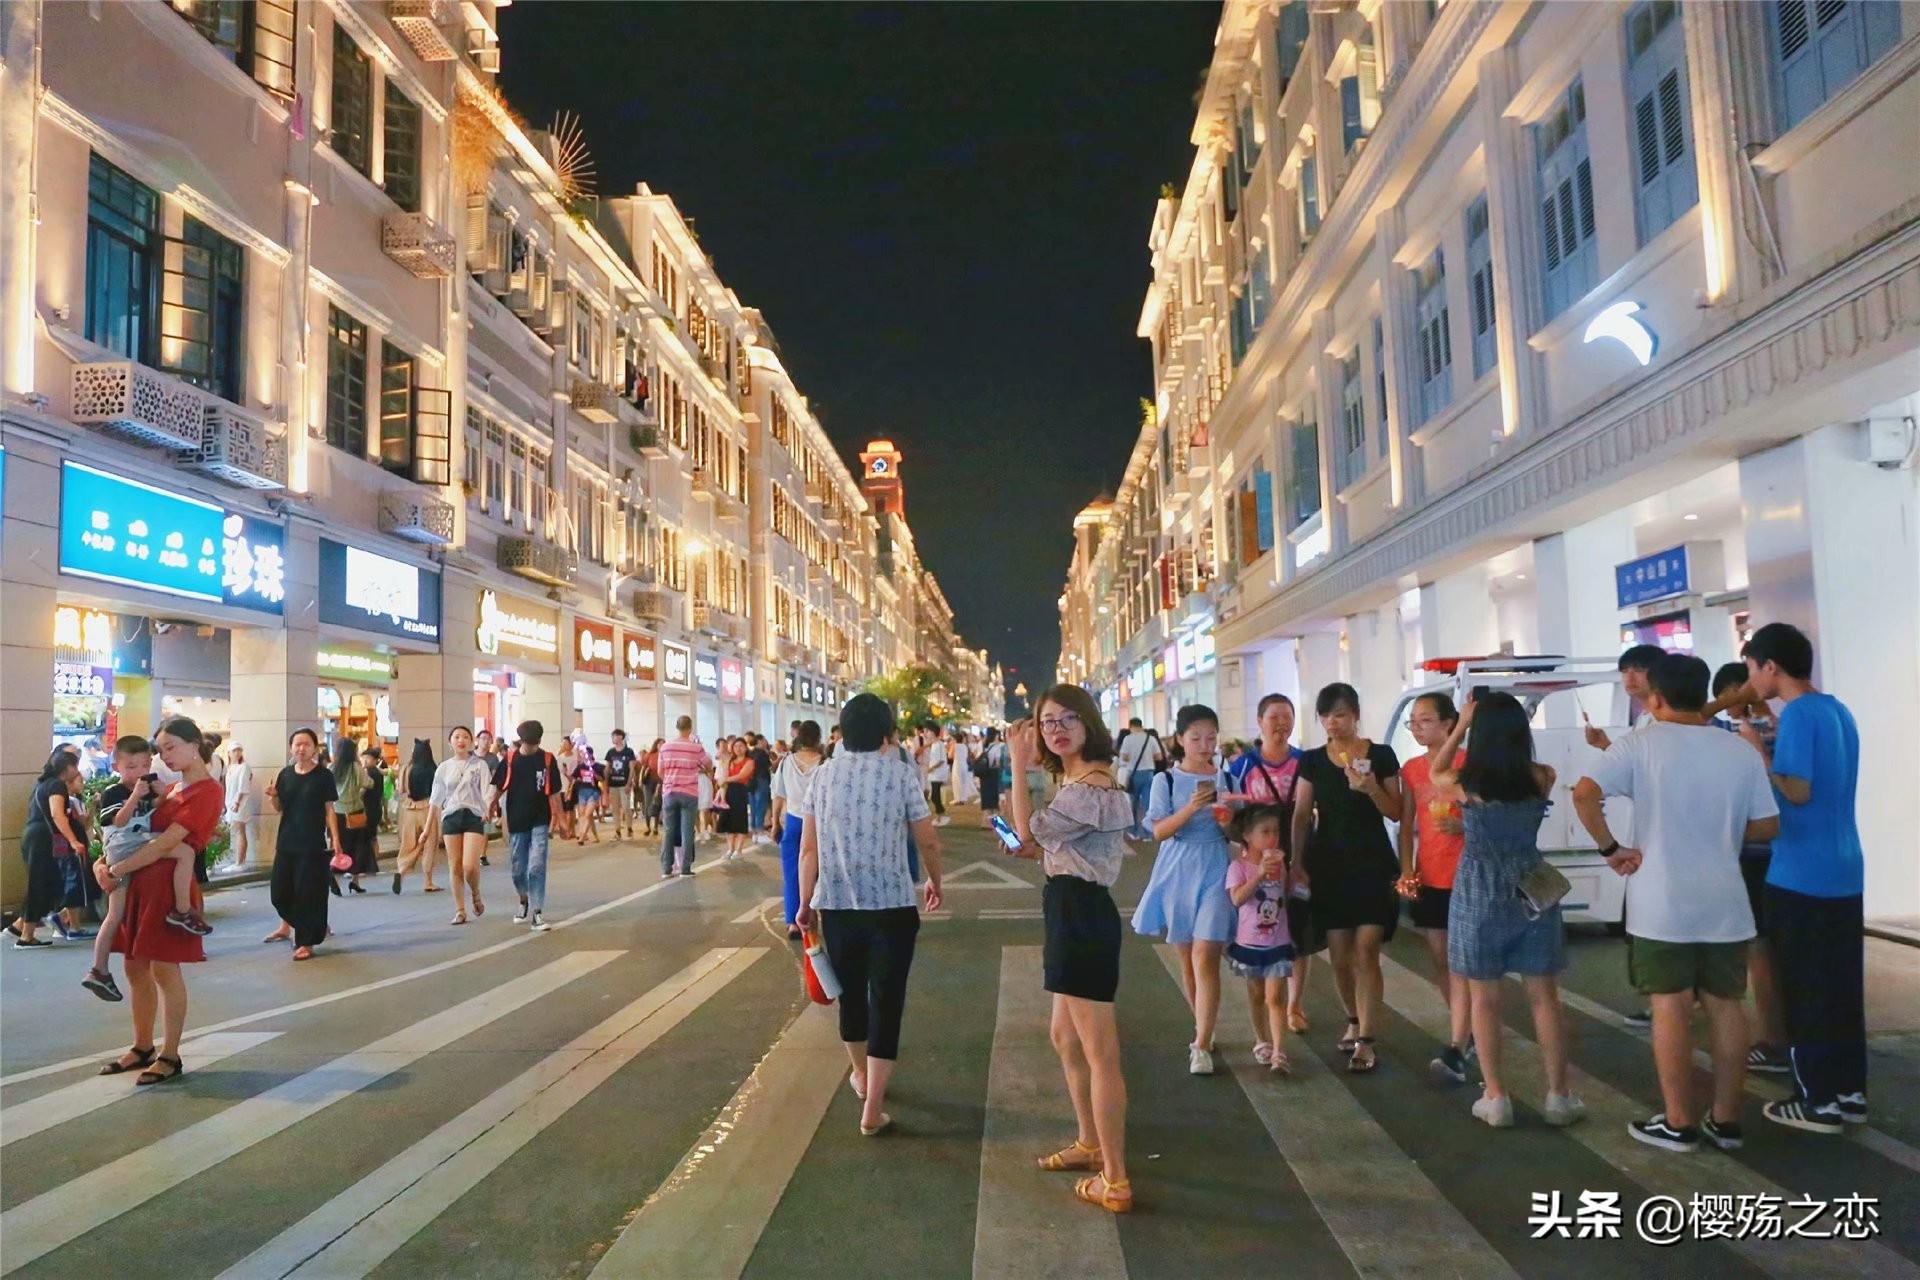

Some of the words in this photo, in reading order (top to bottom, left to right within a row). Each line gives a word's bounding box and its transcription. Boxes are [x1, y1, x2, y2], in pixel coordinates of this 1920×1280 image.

[222, 535, 284, 602] 珍珠
[1635, 560, 1667, 583] 中山路
